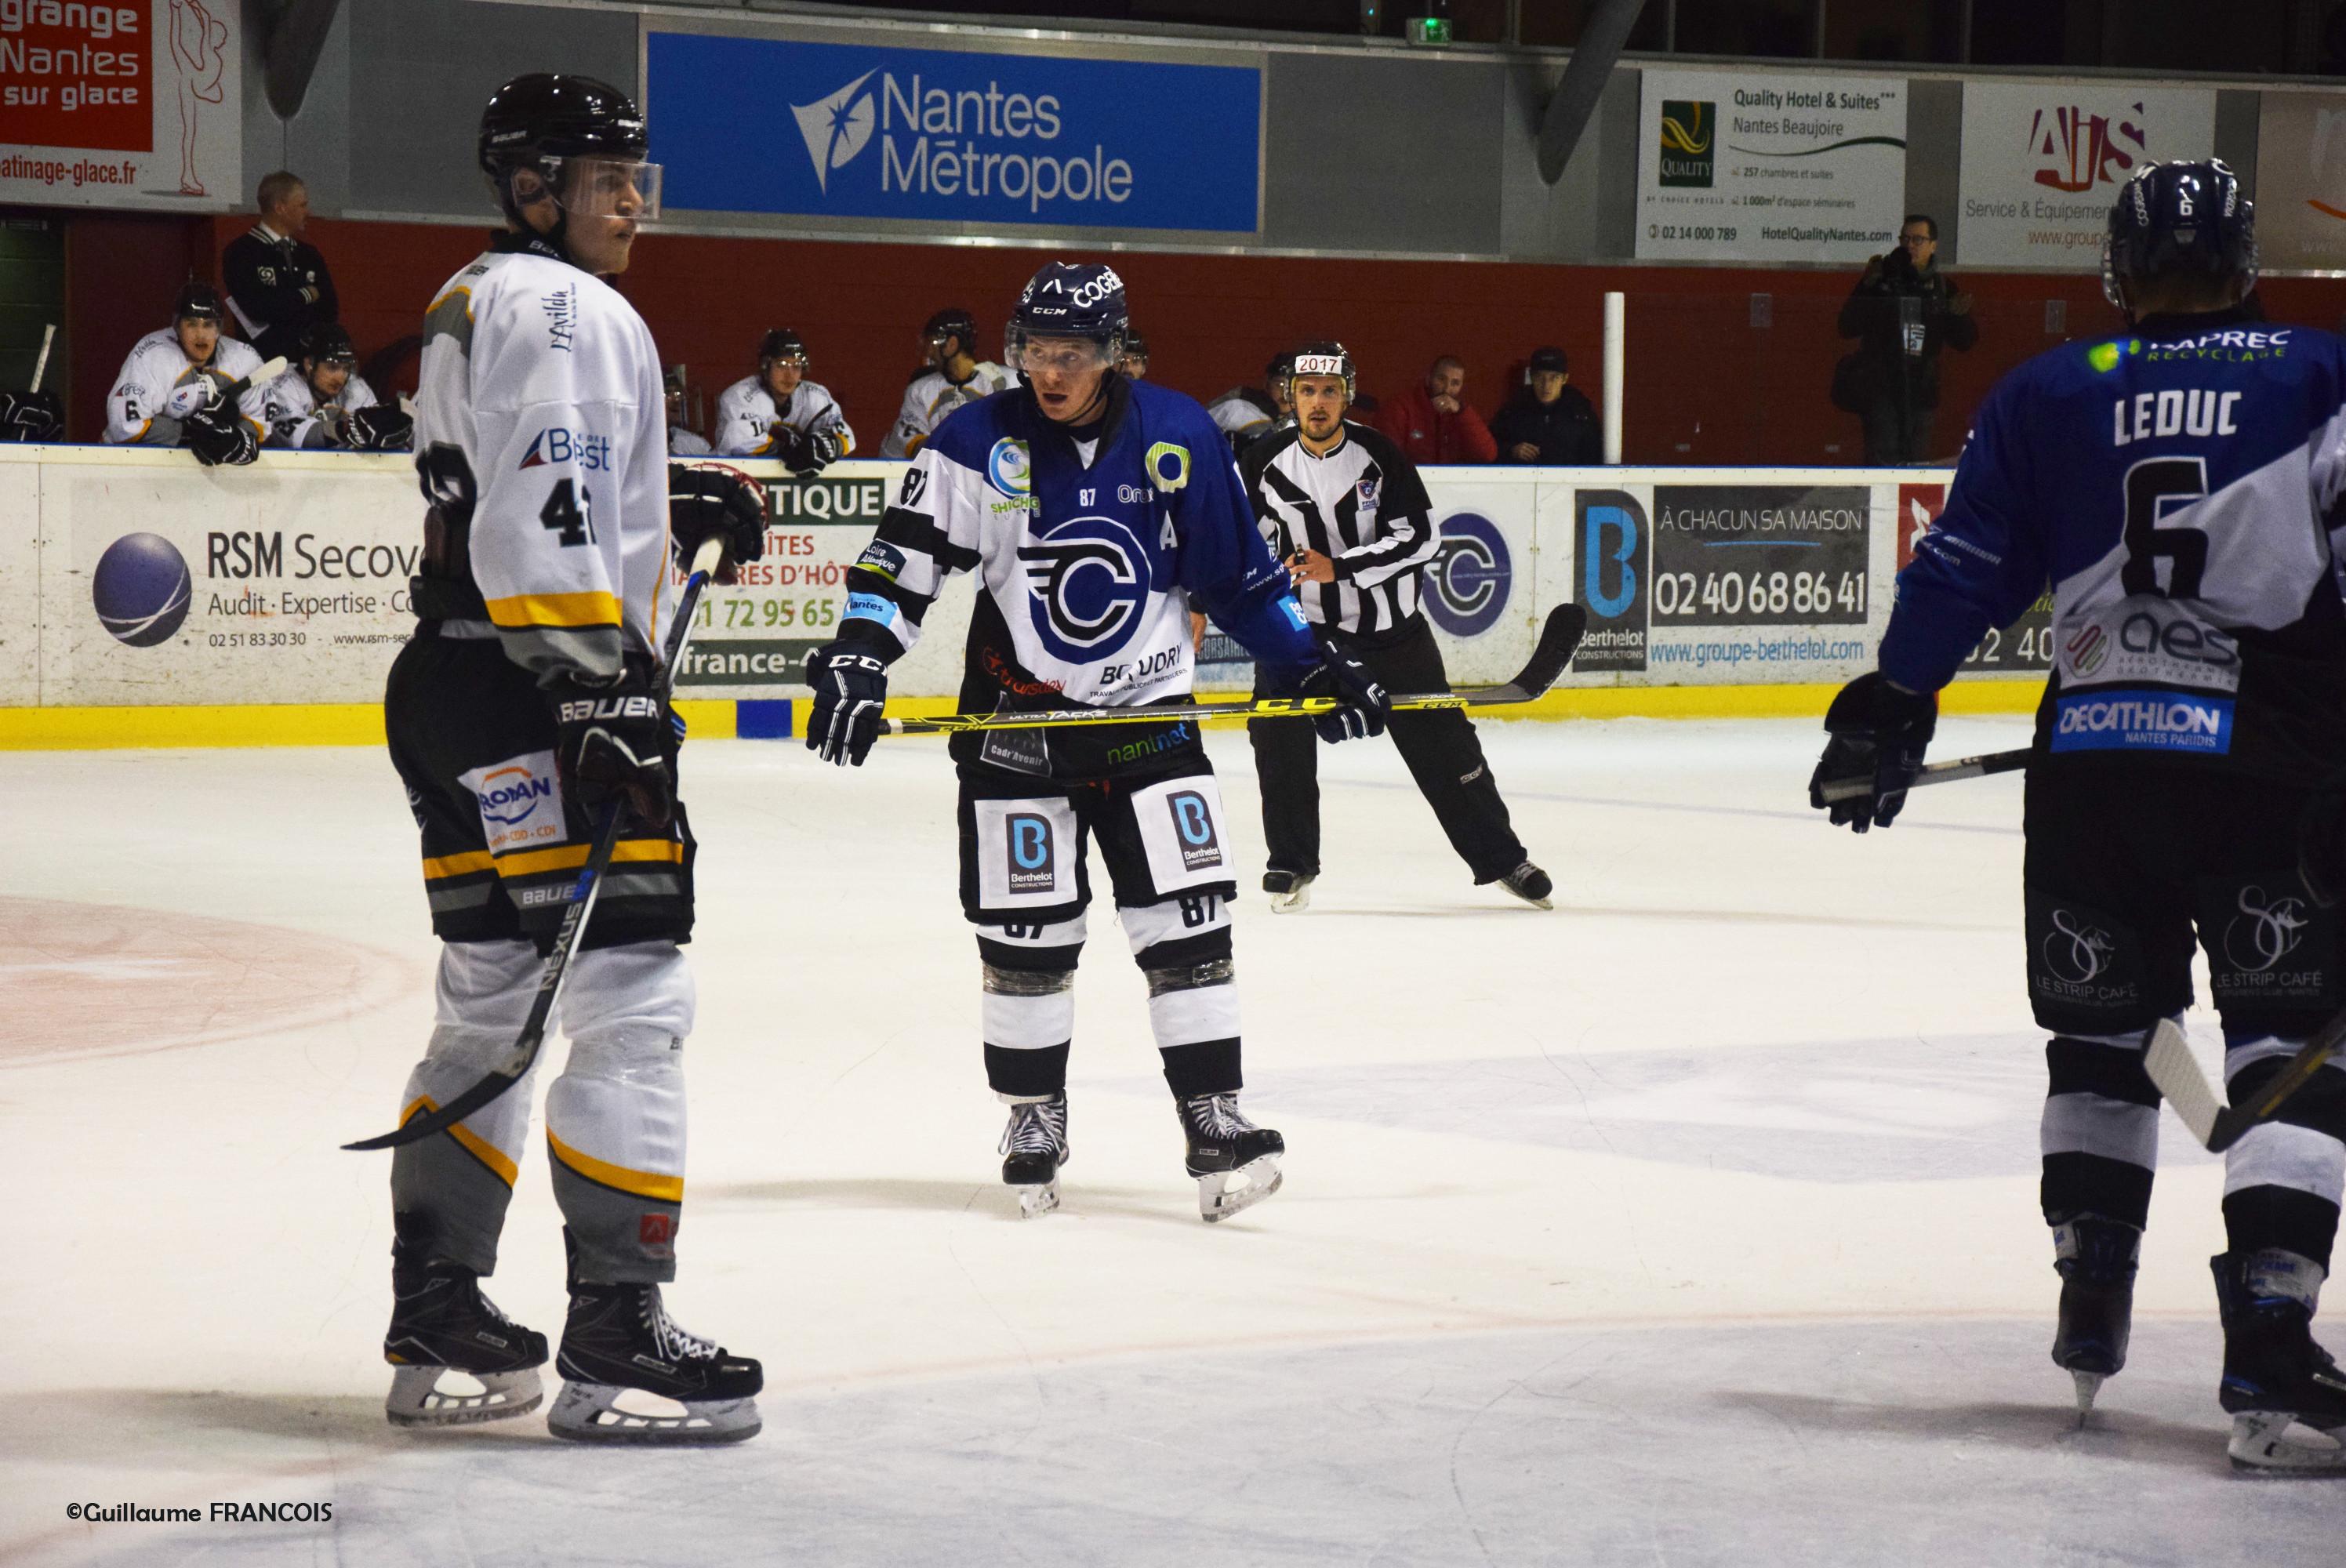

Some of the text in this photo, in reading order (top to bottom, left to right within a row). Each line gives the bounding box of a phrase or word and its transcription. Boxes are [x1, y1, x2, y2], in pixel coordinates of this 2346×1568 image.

[0, 0, 138, 38] grange
[0, 38, 139, 76] Nantes
[4, 81, 138, 111] sur glace
[883, 72, 1061, 140] Nantes
[1734, 89, 1783, 110] Quality
[1786, 91, 1821, 108] Hotel
[1826, 93, 1836, 108] &
[1734, 117, 1843, 139] Nantes Beaujoire
[0, 155, 136, 187] atinage-glace.fr
[1661, 158, 1713, 177] QUALITY
[1744, 167, 1760, 177] 257
[1760, 168, 1799, 180] chambres
[1966, 199, 2017, 218] Service
[2021, 201, 2030, 218] &
[2180, 200, 2192, 216] 6
[1661, 226, 1737, 241] 02 14 000 789
[1762, 227, 1892, 244] HotelQualityNantes.com
[1032, 307, 1067, 316] CCM
[2150, 330, 2292, 350] APREC
[1300, 358, 1338, 372] 2017
[2148, 347, 2286, 362] RECYCLAGE
[2115, 390, 2242, 447] LEDUC
[767, 484, 880, 521] TIQUE
[1080, 488, 1096, 506] 87
[1661, 505, 1862, 531] À CHACUN SA MAISON
[2122, 456, 2210, 600] 6
[1160, 510, 1178, 550] A
[208, 530, 419, 579] RSM Secov
[780, 561, 849, 586] D'HÔT
[1656, 571, 1865, 615] 02 40 68 86 41
[208, 592, 266, 615] Audit
[282, 592, 376, 619] Expertise
[693, 598, 834, 627] 1 72 95 65
[209, 632, 413, 648] 02 51 83 30 30 www.rsm-sec
[2017, 626, 2055, 662] 40
[2120, 612, 2239, 666] aes
[1576, 650, 1644, 660] CONSTRUCTIONS
[1651, 637, 1864, 667] www.groupe-berthelot.com
[560, 696, 659, 723] BAUER
[1255, 696, 1338, 713] CC
[1047, 710, 1108, 721] TACKS
[2059, 702, 2221, 735] DECATHLON
[1107, 723, 1191, 765] nantnet
[2126, 731, 2217, 747] NANTES PARIDIS
[1184, 847, 1219, 861] Berthelot
[1011, 872, 1053, 883] Berthelot
[522, 884, 576, 905] BAUE
[2233, 972, 2275, 987] STRIP
[2279, 969, 2323, 987] CAFÉ
[2054, 981, 2095, 998] STRIP
